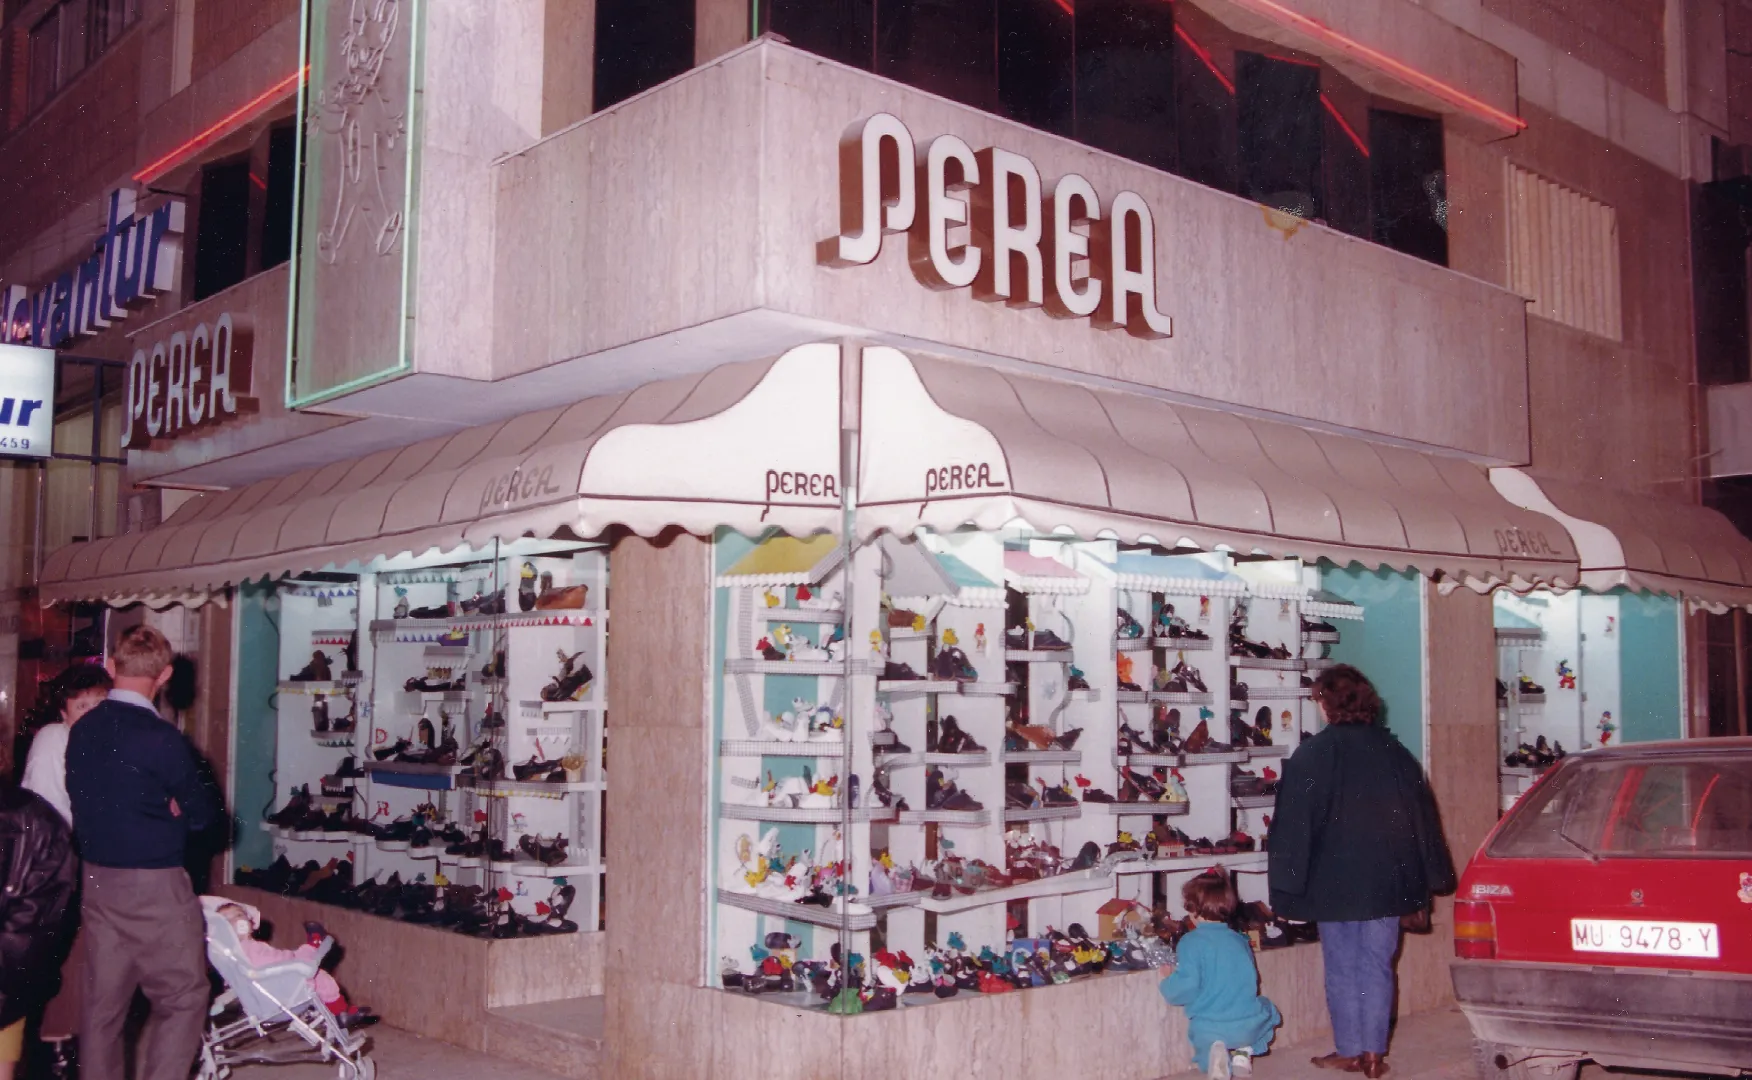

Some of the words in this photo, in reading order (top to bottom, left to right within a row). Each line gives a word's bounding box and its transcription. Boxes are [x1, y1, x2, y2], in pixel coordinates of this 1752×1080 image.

[832, 112, 1172, 339] PEREA
[121, 312, 237, 448] PEREA
[478, 464, 560, 516] PEREA
[760, 469, 840, 522] PEREA
[919, 462, 1005, 519] PEREA
[1494, 528, 1562, 571] PEREA
[1471, 884, 1513, 897] IBIZA
[1574, 923, 1605, 948] MU
[1619, 925, 1683, 951] 9478
